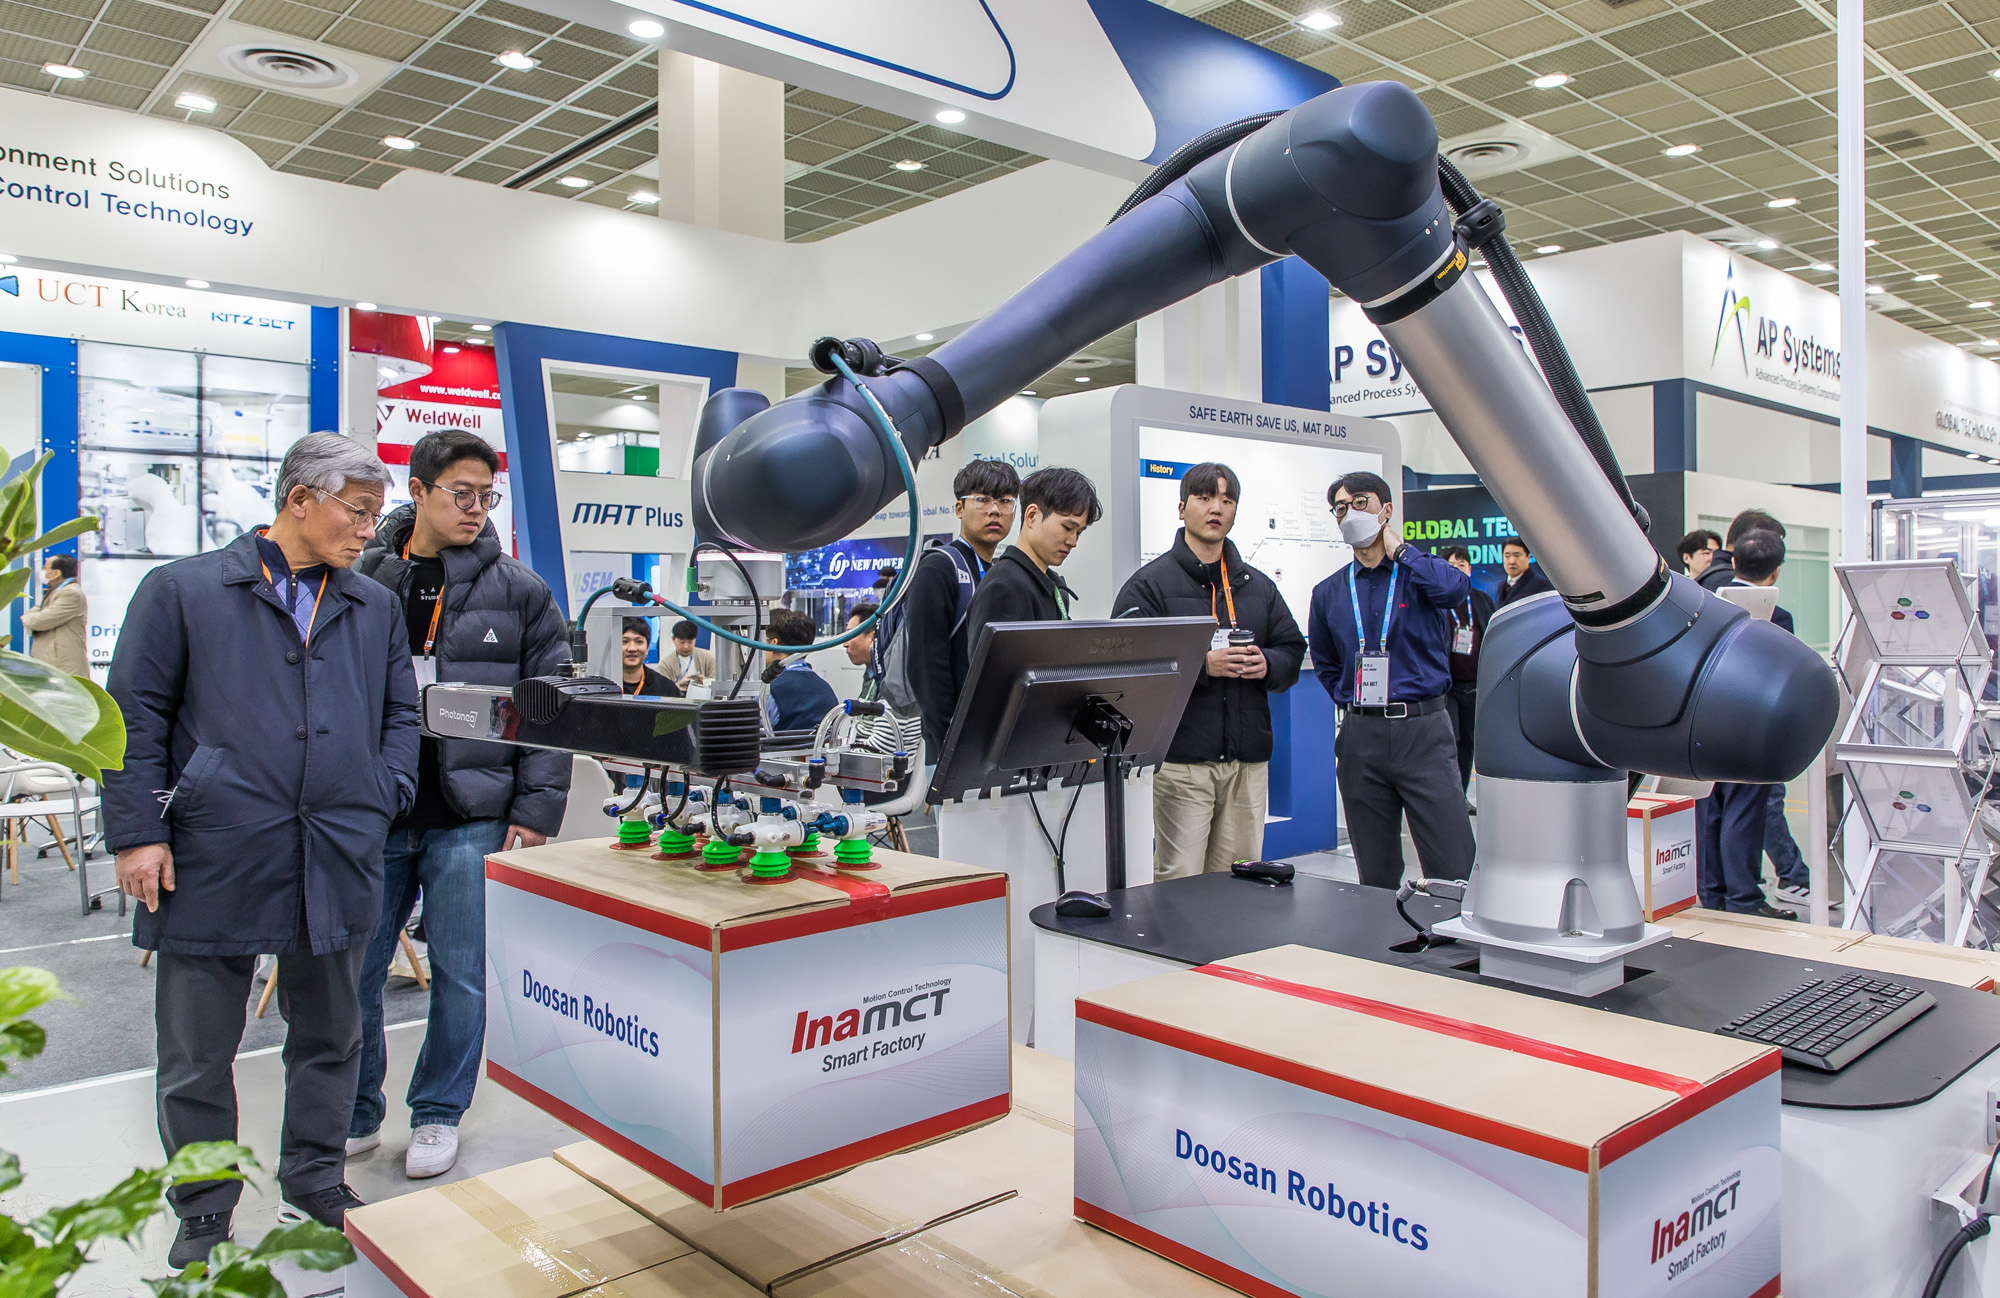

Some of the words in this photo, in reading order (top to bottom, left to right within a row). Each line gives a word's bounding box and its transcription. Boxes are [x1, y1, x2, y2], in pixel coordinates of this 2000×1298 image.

[107, 161, 230, 199] Solutions
[100, 192, 254, 237] Technology
[38, 279, 109, 308] UCT
[121, 288, 187, 318] Korea
[211, 311, 254, 326] KITZ
[259, 317, 296, 331] SCT
[1756, 316, 1778, 357] AP
[1783, 325, 1840, 379] Systems
[1363, 385, 1402, 401] Process
[406, 407, 481, 429] WeldWell
[1189, 405, 1217, 422] SAFE
[1220, 409, 1253, 428] EARTH
[1256, 414, 1282, 431] SAVE
[1283, 418, 1300, 434] US,
[1302, 420, 1322, 436] MAT
[1324, 424, 1347, 439] PLUS
[1150, 463, 1174, 476] History
[572, 502, 644, 526] MAT
[645, 507, 684, 528] Plus
[1403, 518, 1479, 541] GLOBAL
[850, 558, 872, 571] NEW
[871, 557, 905, 571] POWER
[92, 648, 109, 658] On
[439, 707, 475, 723] Photoneo
[862, 992, 887, 1004] Motion
[888, 985, 913, 999] Control
[914, 977, 952, 992] Technology
[523, 968, 579, 1021] Doosan
[583, 994, 659, 1057] Robotics
[822, 1045, 869, 1073] Smart
[872, 1032, 926, 1059] Factory
[1175, 1128, 1277, 1194] Doosan
[1287, 1169, 1429, 1251] Robotics
[1667, 1249, 1695, 1281] Smart
[1695, 1229, 1727, 1262] Factory
